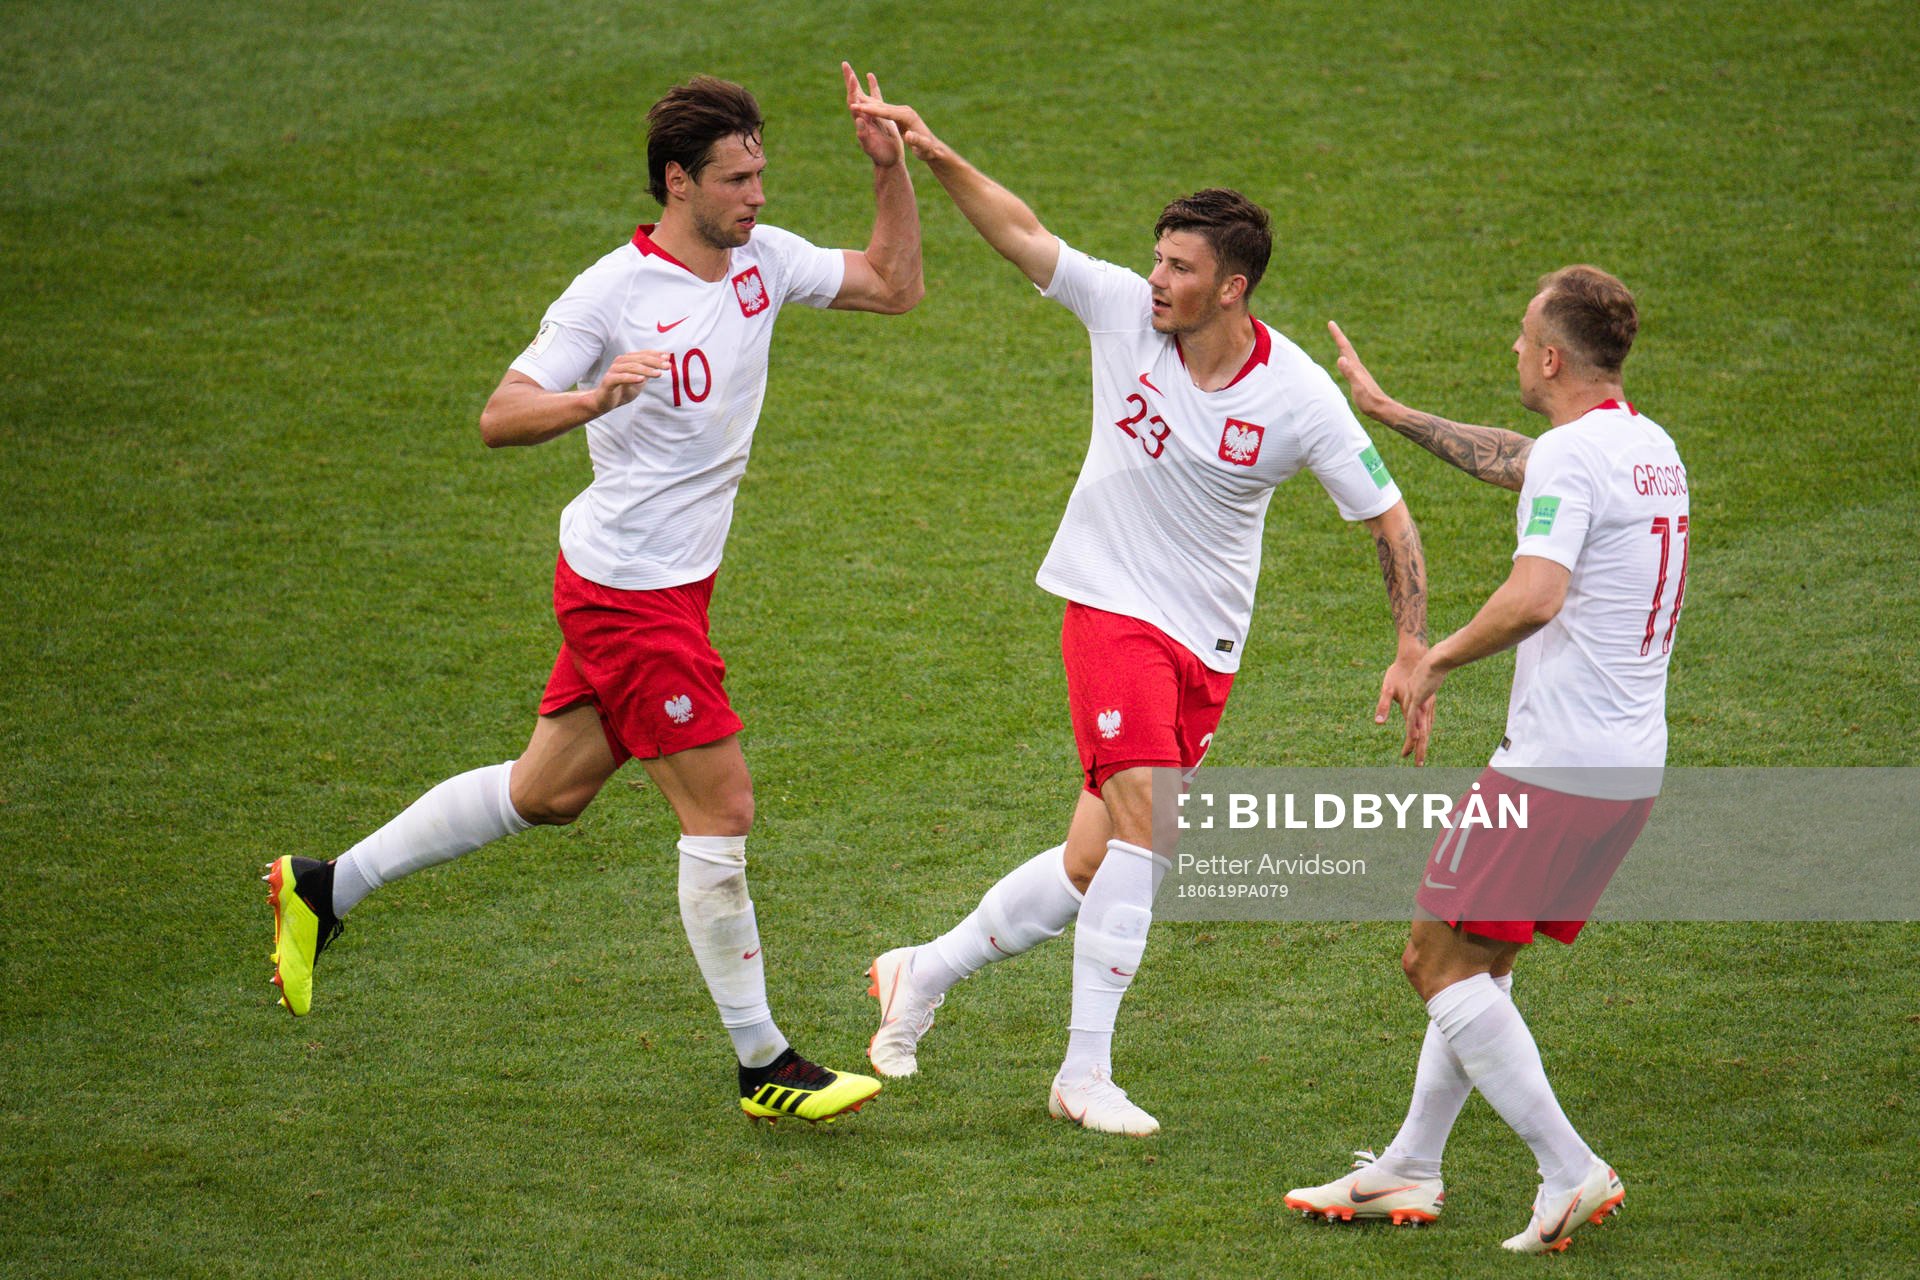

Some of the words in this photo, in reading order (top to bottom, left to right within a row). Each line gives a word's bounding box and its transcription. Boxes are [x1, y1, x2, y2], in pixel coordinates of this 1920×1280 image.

[669, 348, 711, 405] 10
[1115, 393, 1171, 459] 23
[1640, 515, 1688, 657] 11
